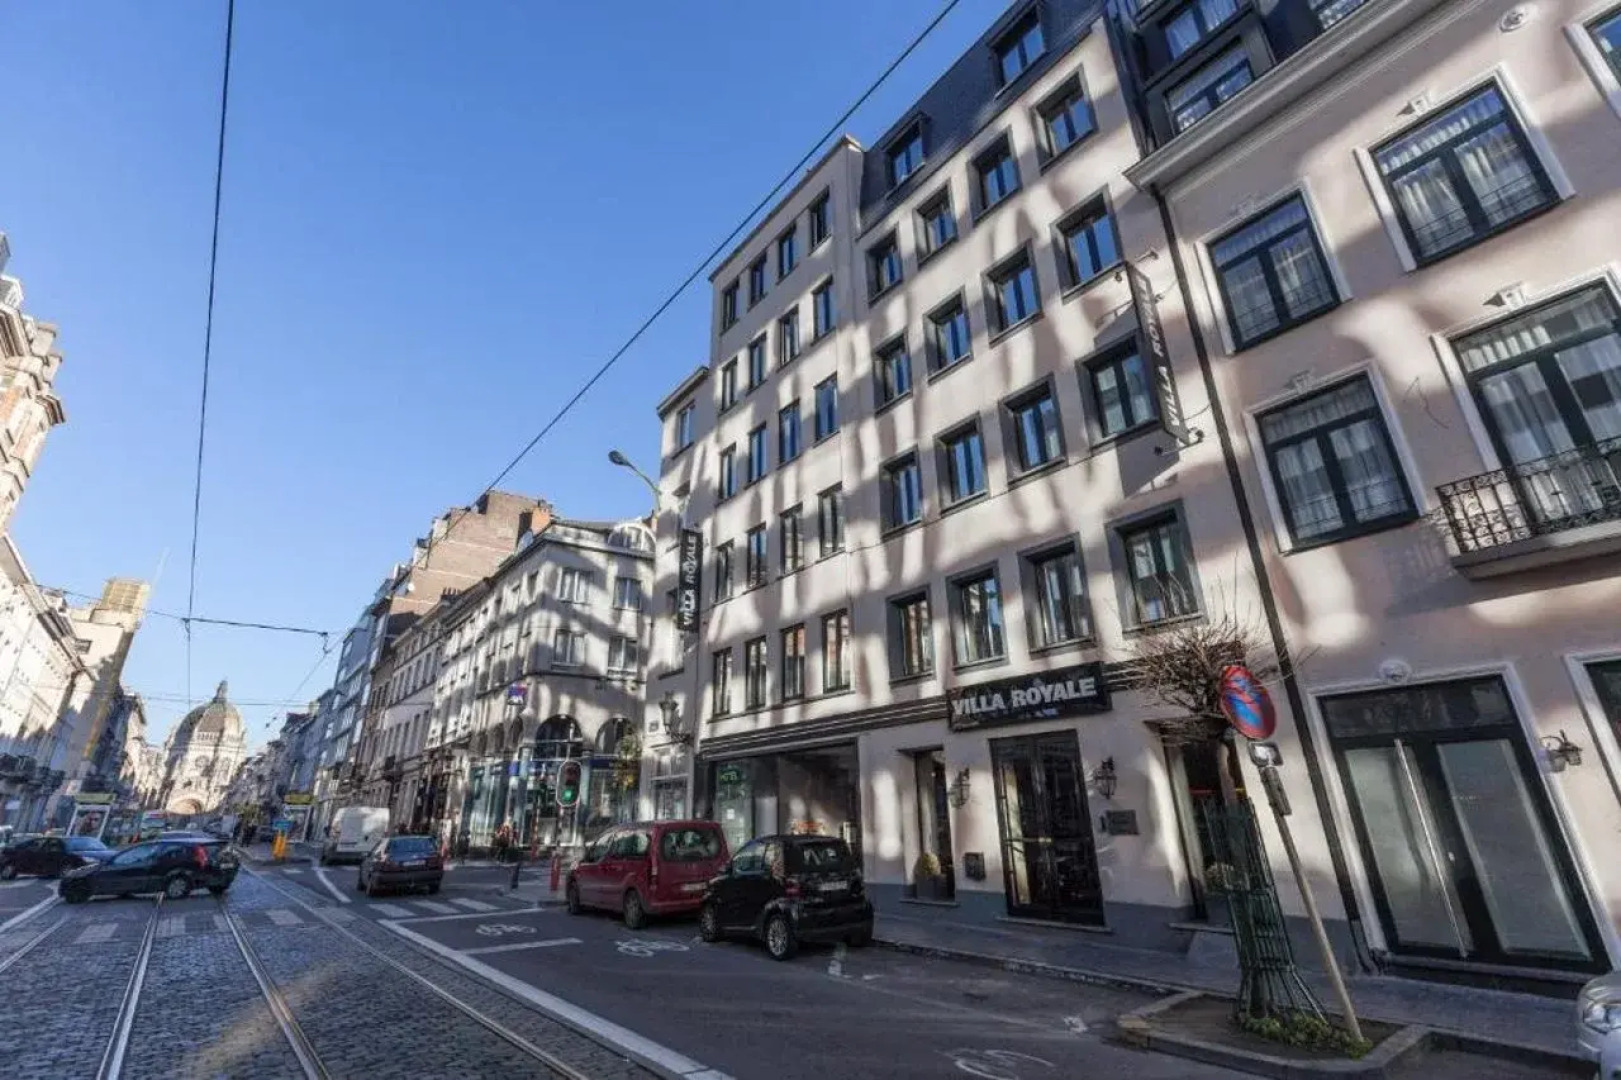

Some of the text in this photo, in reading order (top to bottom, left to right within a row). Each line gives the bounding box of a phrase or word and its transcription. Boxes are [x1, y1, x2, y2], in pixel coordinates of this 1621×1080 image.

[1158, 366, 1180, 427] VILLA
[683, 535, 698, 625] VILLA ROYALE
[952, 693, 1006, 715] VILLA
[1011, 677, 1097, 707] ROYALE
